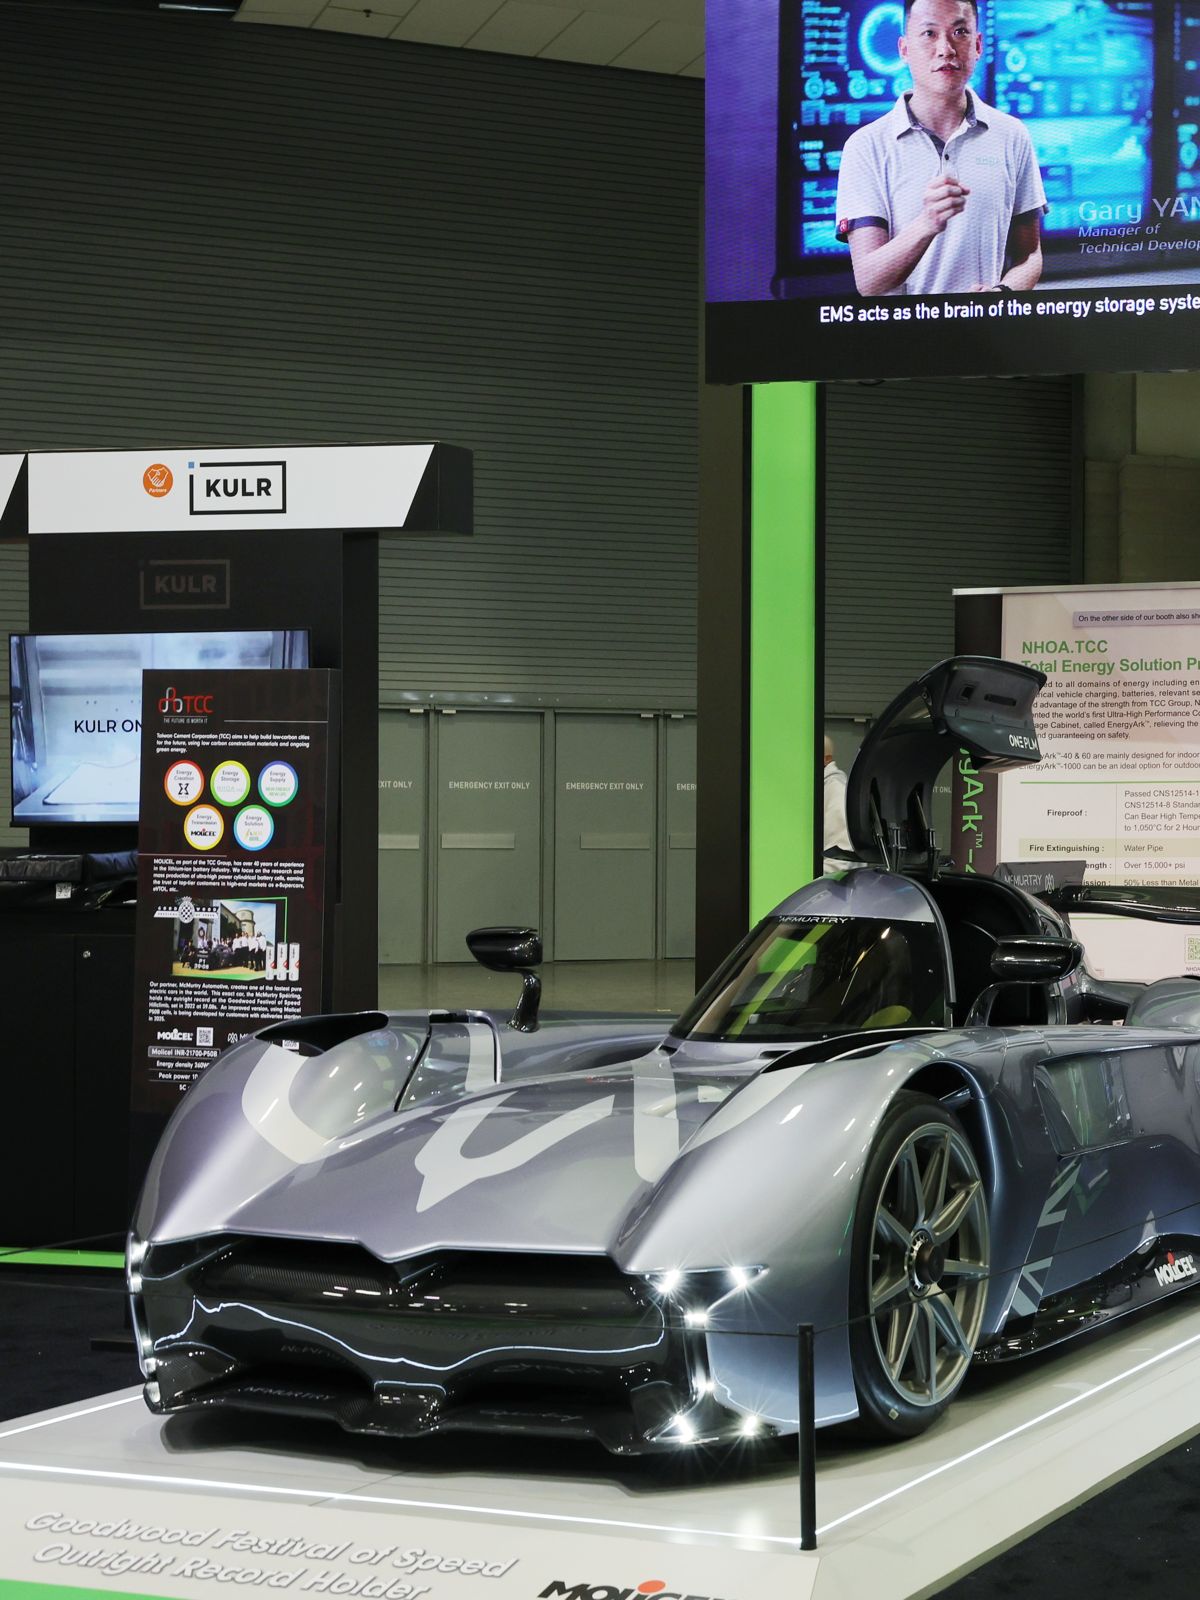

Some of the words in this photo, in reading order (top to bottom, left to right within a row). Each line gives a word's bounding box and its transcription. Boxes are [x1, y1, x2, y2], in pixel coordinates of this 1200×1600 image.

[1078, 201, 1142, 224] Gary
[1078, 226, 1140, 239] Manager
[1145, 223, 1160, 234] of
[1080, 240, 1143, 254] Technical
[820, 305, 853, 322] EMS
[857, 304, 889, 321] acts
[893, 307, 911, 320] as
[915, 302, 939, 319] the
[944, 300, 983, 318] brain
[988, 299, 1004, 316] of
[1007, 298, 1031, 315] the
[1036, 300, 1091, 319] energy
[1095, 295, 1155, 316] storage
[206, 478, 271, 498] KULR
[155, 574, 216, 594] KULR
[1077, 614, 1088, 622] On
[1089, 614, 1100, 622] the
[1101, 614, 1119, 623] other
[1119, 613, 1134, 621] side
[1155, 612, 1174, 620] booth
[1175, 612, 1189, 620] also
[1021, 639, 1108, 654] NHOA.TCC
[1062, 658, 1115, 676] Energy
[1119, 657, 1181, 671] Solution
[1055, 680, 1063, 688] to
[1077, 680, 1110, 688] domains
[1112, 679, 1120, 687] of
[1122, 680, 1149, 690] energy
[1151, 679, 1187, 689] including
[183, 696, 213, 713] TCC
[1064, 710, 1090, 719] world's
[1091, 710, 1105, 718] first
[1106, 710, 1142, 719] Ultra-High
[1144, 709, 1190, 717] Performance
[74, 719, 116, 733] KULR
[379, 780, 391, 788] XIT
[392, 780, 412, 788] ONLY
[448, 780, 492, 789] EMERGENCY
[494, 781, 509, 789] EXIT
[566, 782, 607, 790] EMERGENCY
[609, 782, 624, 790] EXIT
[625, 782, 643, 790] ONLY
[1124, 789, 1151, 797] Passed
[1152, 789, 1199, 797] CNS12514-1
[1124, 800, 1170, 809] CNS12514-8
[1047, 809, 1083, 818] Fireproof
[1124, 812, 1139, 820] Can
[1140, 812, 1158, 820] Bear
[1159, 812, 1177, 821] High
[1133, 823, 1162, 832] 1,050°C
[1163, 823, 1173, 831] for
[1175, 823, 1180, 831] 2
[1046, 844, 1099, 853] Extinguishing
[1123, 844, 1145, 852] Water
[1146, 844, 1163, 852] Pipe
[1123, 861, 1141, 869] Over
[1143, 861, 1172, 869] 15,000+
[1174, 862, 1185, 870] psi
[151, 1048, 173, 1056] Molicel
[156, 1060, 174, 1069] Energy
[174, 1061, 193, 1069] density
[173, 1073, 190, 1081] power
[25, 1511, 220, 1549] Goodwood
[211, 1528, 353, 1561] Festival
[348, 1546, 398, 1566] of
[392, 1549, 519, 1578] Speed
[33, 1543, 176, 1576] Outright
[171, 1556, 307, 1588] Record
[301, 1570, 431, 1600] Holder
